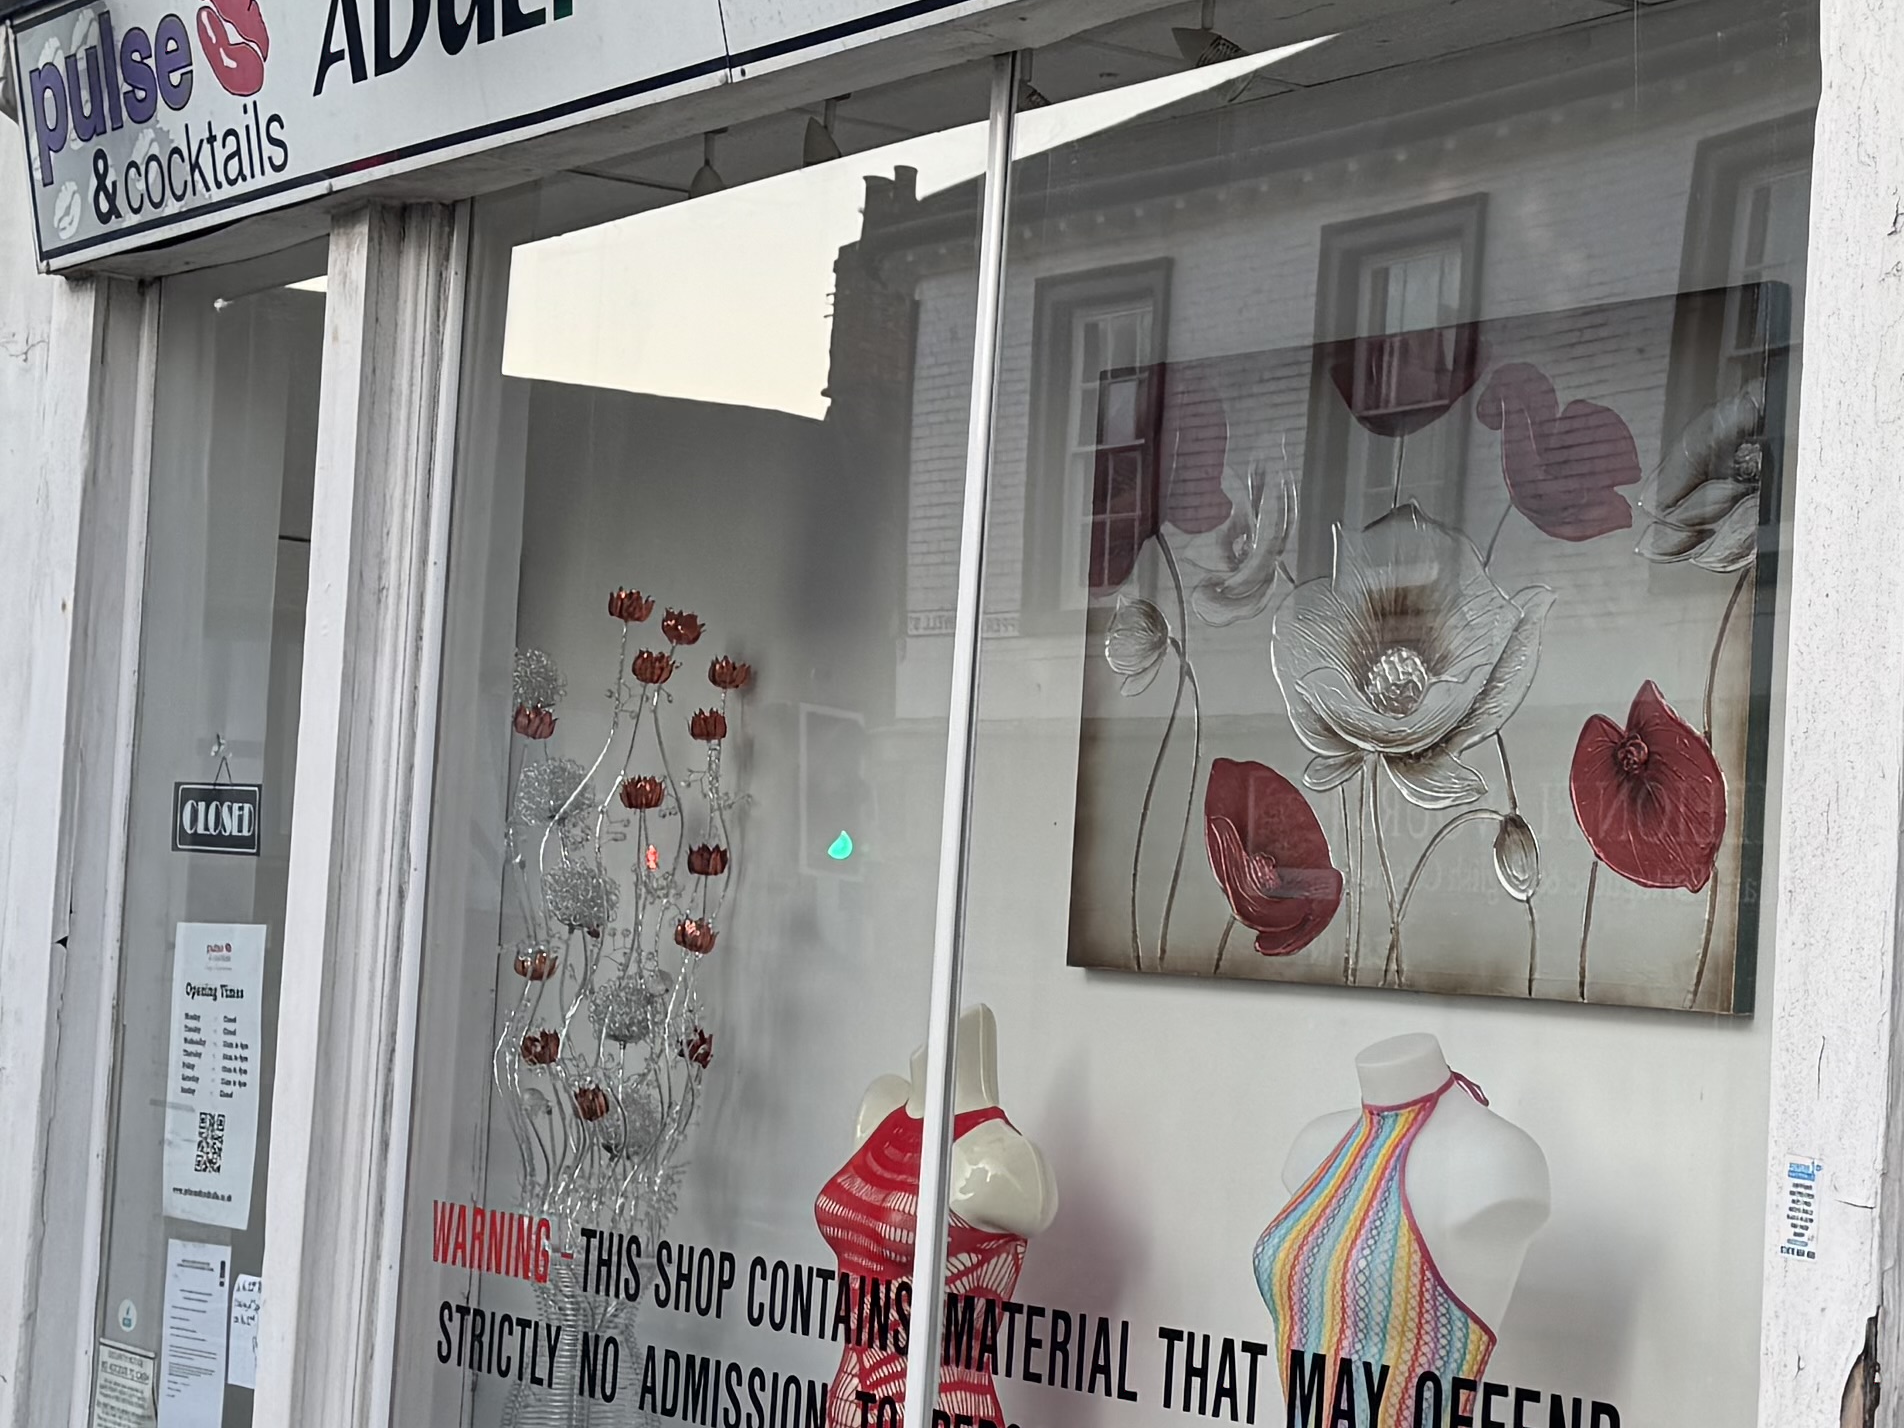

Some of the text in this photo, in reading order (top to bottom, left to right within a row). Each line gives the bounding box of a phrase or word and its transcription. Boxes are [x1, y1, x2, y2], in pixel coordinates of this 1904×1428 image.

[29, 8, 194, 186] pulse
[123, 100, 291, 210] cocktails
[182, 799, 255, 837] CLOSED
[433, 1198, 552, 1283] WARNING
[581, 1228, 643, 1302] THIS
[654, 1239, 736, 1320] SHOP
[746, 1256, 914, 1357] CONTAINS
[943, 1291, 1139, 1403] MATERIAL
[1158, 1326, 1269, 1426] THAT
[437, 1300, 562, 1390] STRICTLY
[578, 1329, 620, 1404] NO
